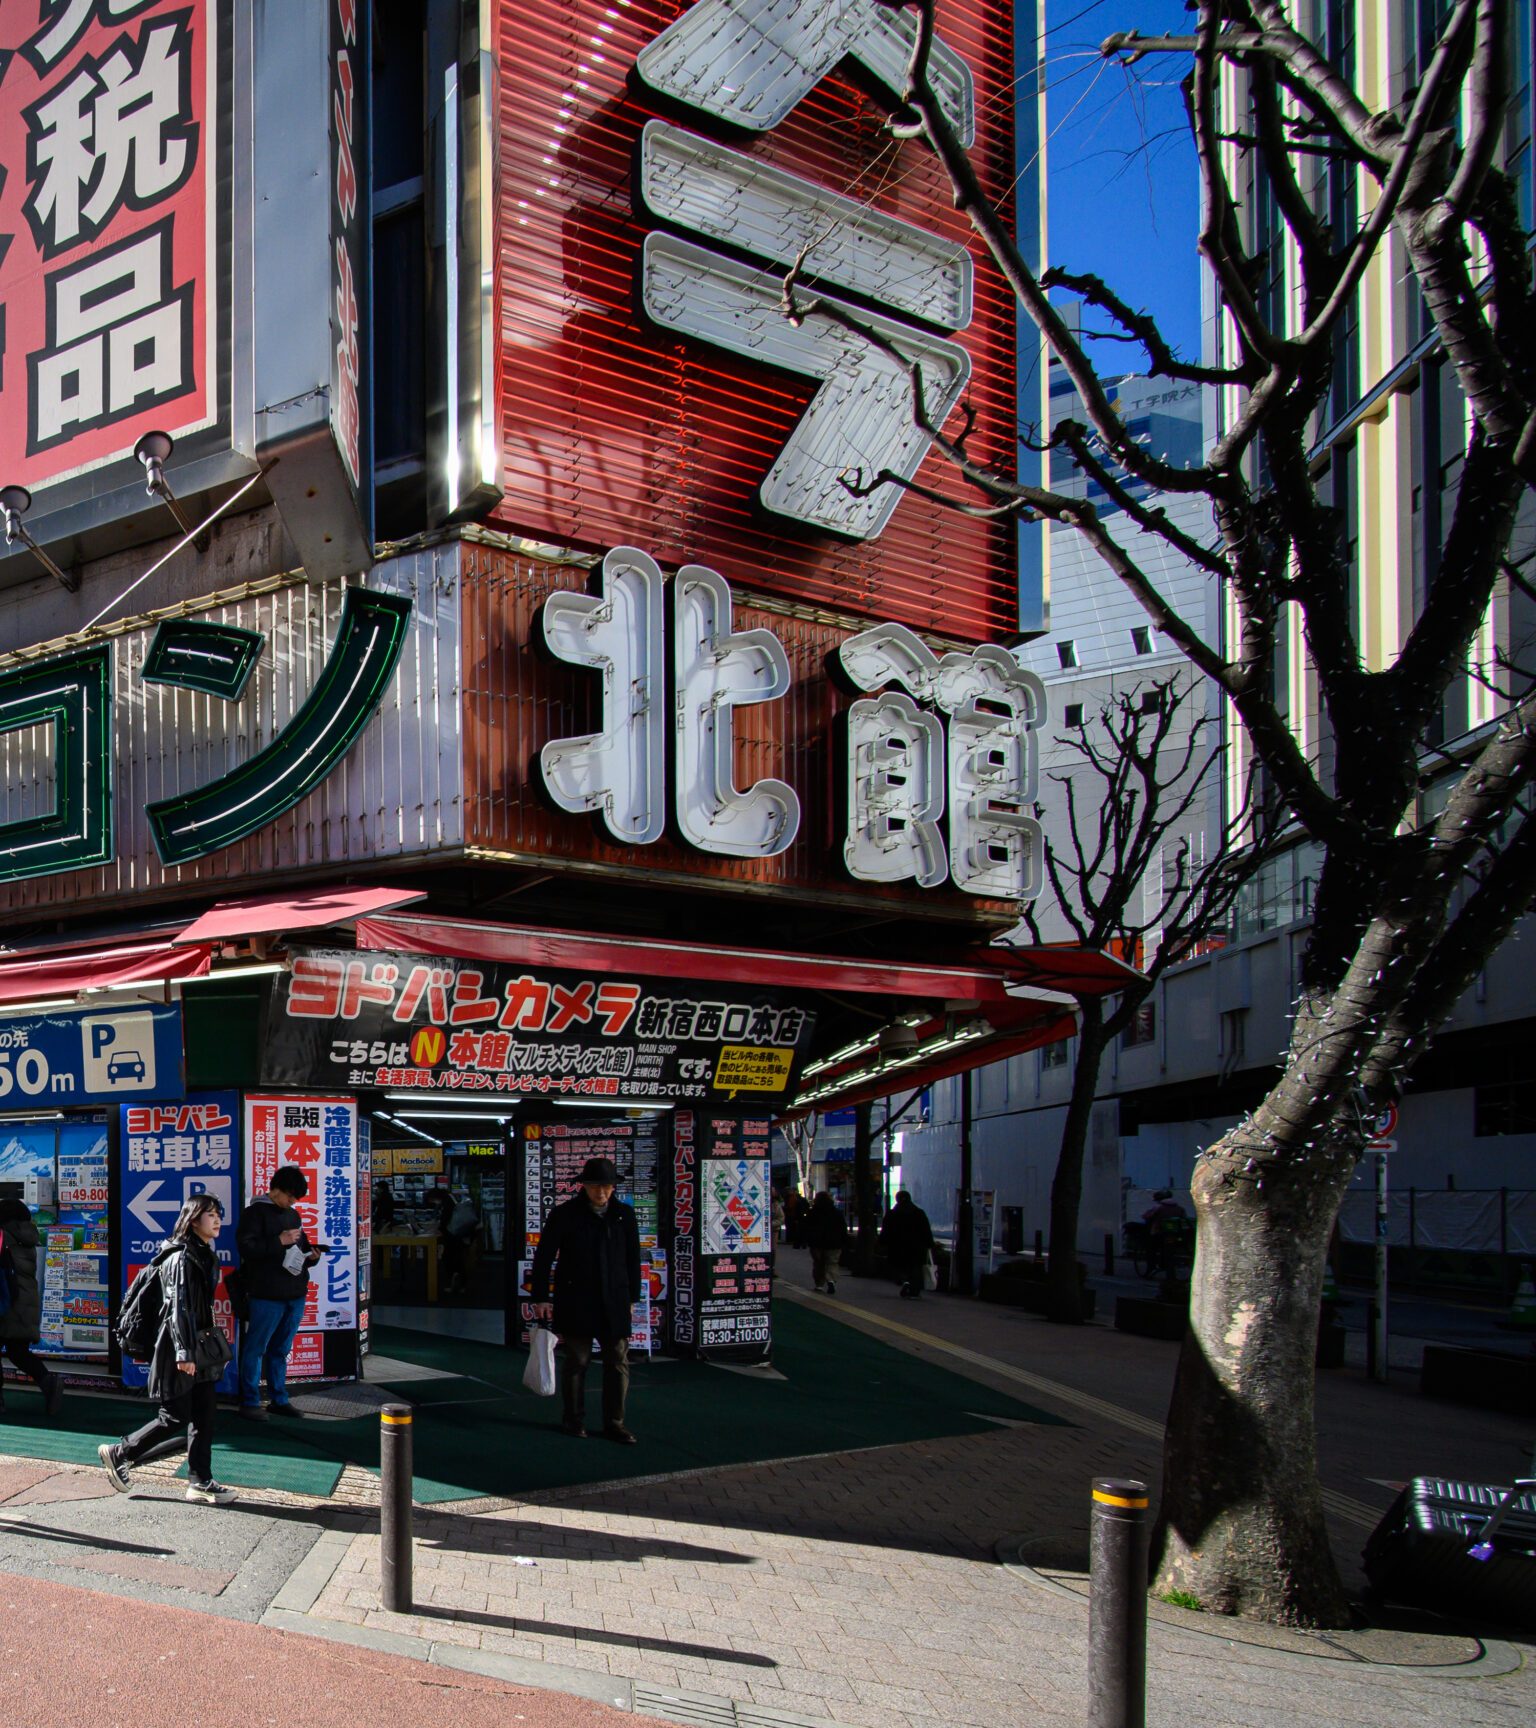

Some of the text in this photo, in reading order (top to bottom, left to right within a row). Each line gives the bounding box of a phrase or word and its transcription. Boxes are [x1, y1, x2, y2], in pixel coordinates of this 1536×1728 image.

[541, 547, 1048, 900] 北館
[287, 956, 641, 1036] ヨドバシカメラ
[635, 997, 806, 1046] 新宿西口本店
[92, 1024, 116, 1060] P
[330, 1040, 409, 1066] こちらは
[415, 1031, 441, 1064] N
[638, 1043, 677, 1055] MAIN SHOP
[635, 1055, 664, 1066] (NORTH)
[678, 1057, 713, 1081] です。
[348, 1069, 373, 1085] 主に
[620, 1081, 707, 1098] を取り扱っています。
[127, 1104, 232, 1135] ヨドバシ
[284, 1106, 320, 1129] 最短
[128, 1134, 232, 1173] 駐車場
[400, 1156, 435, 1166] MacBook
[674, 1110, 695, 1235] ヨドバシカメラ
[323, 1105, 352, 1303] 冷蔵庫・洗濯機・テレビ
[674, 1235, 695, 1344] 新宿西口本店
[64, 1298, 109, 1317] 一人暮らし
[702, 1317, 735, 1331] 営業時間
[739, 1327, 769, 1342] 10:00
